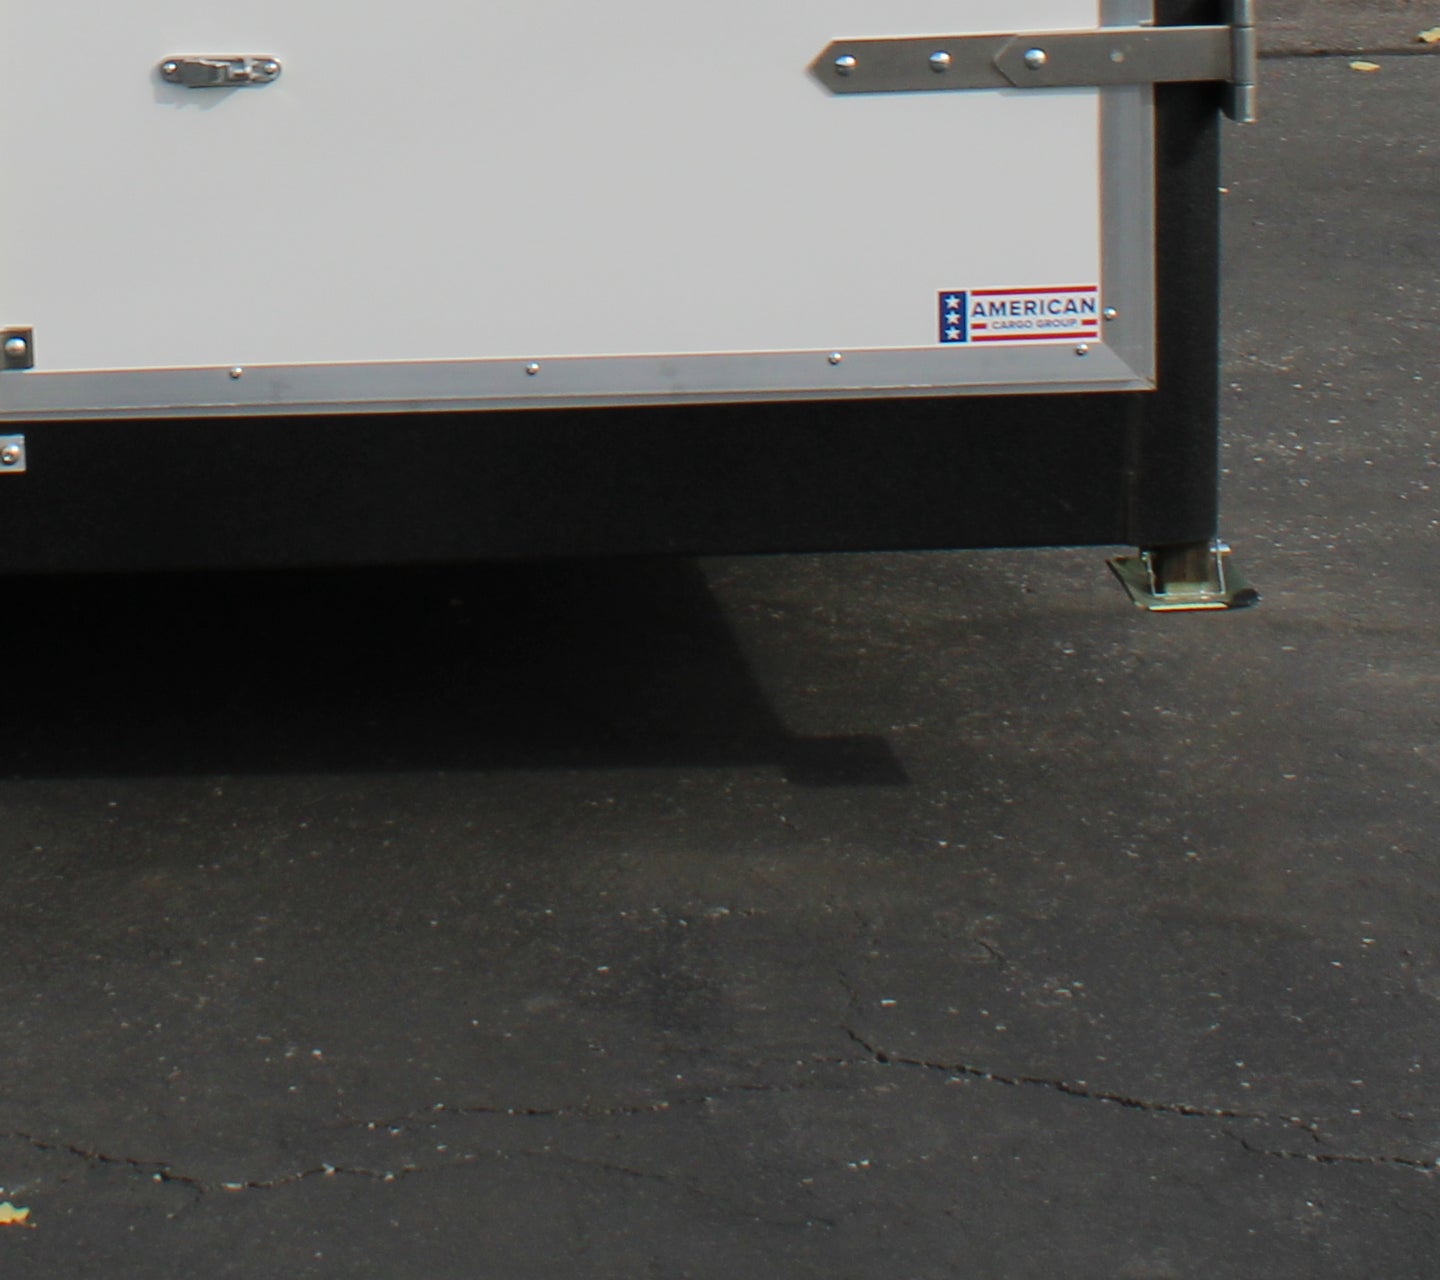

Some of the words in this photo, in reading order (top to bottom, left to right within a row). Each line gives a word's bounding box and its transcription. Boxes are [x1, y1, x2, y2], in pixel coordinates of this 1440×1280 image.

[971, 297, 1097, 318] AMERICAN
[991, 320, 1033, 330] CARGO
[1036, 318, 1078, 328] GROUP
